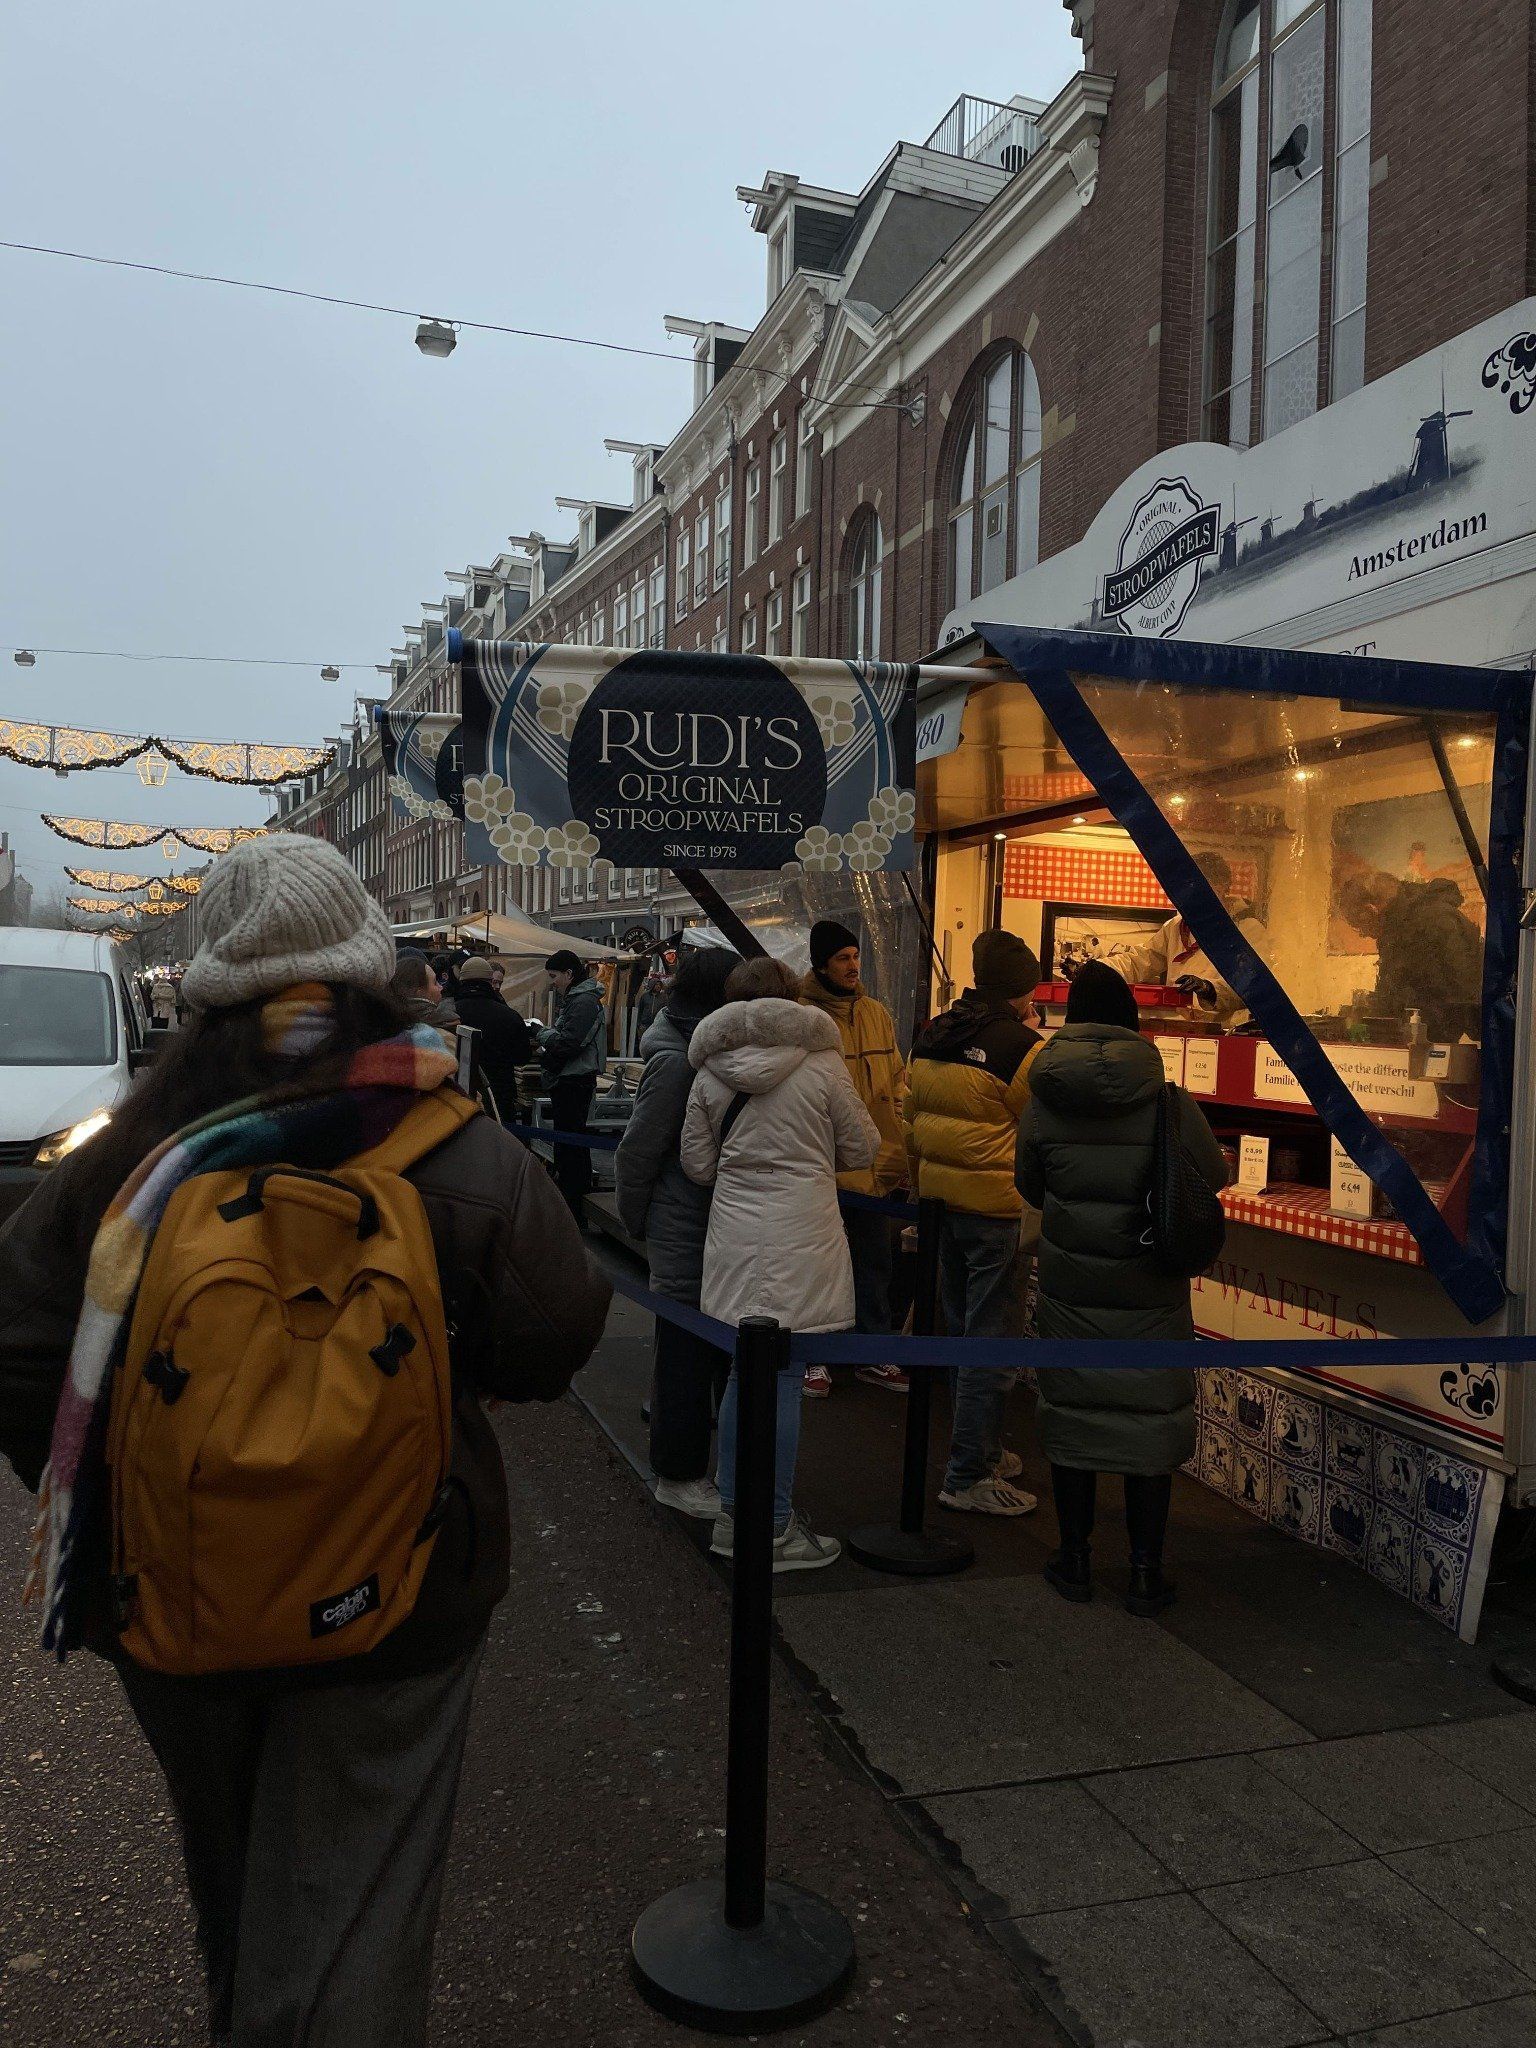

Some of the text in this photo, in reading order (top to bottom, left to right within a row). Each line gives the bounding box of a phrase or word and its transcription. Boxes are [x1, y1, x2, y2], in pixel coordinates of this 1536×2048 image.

[1139, 501, 1177, 532] ORIGINAL
[1347, 512, 1487, 582] Amsterdam
[1109, 521, 1211, 607] STROOPWAFELS
[1138, 600, 1176, 630] ALBERT CUYP
[598, 708, 802, 771] RUDI'S
[618, 773, 782, 805] ORIGINAL
[594, 807, 803, 834] STROOPWAFELS
[663, 844, 737, 859] SINCE 1978
[1354, 1060, 1371, 1074] the
[1373, 1062, 1408, 1078] differe
[1265, 1073, 1295, 1086] Familie
[1357, 1081, 1373, 1094] het
[1374, 1084, 1415, 1098] verschil
